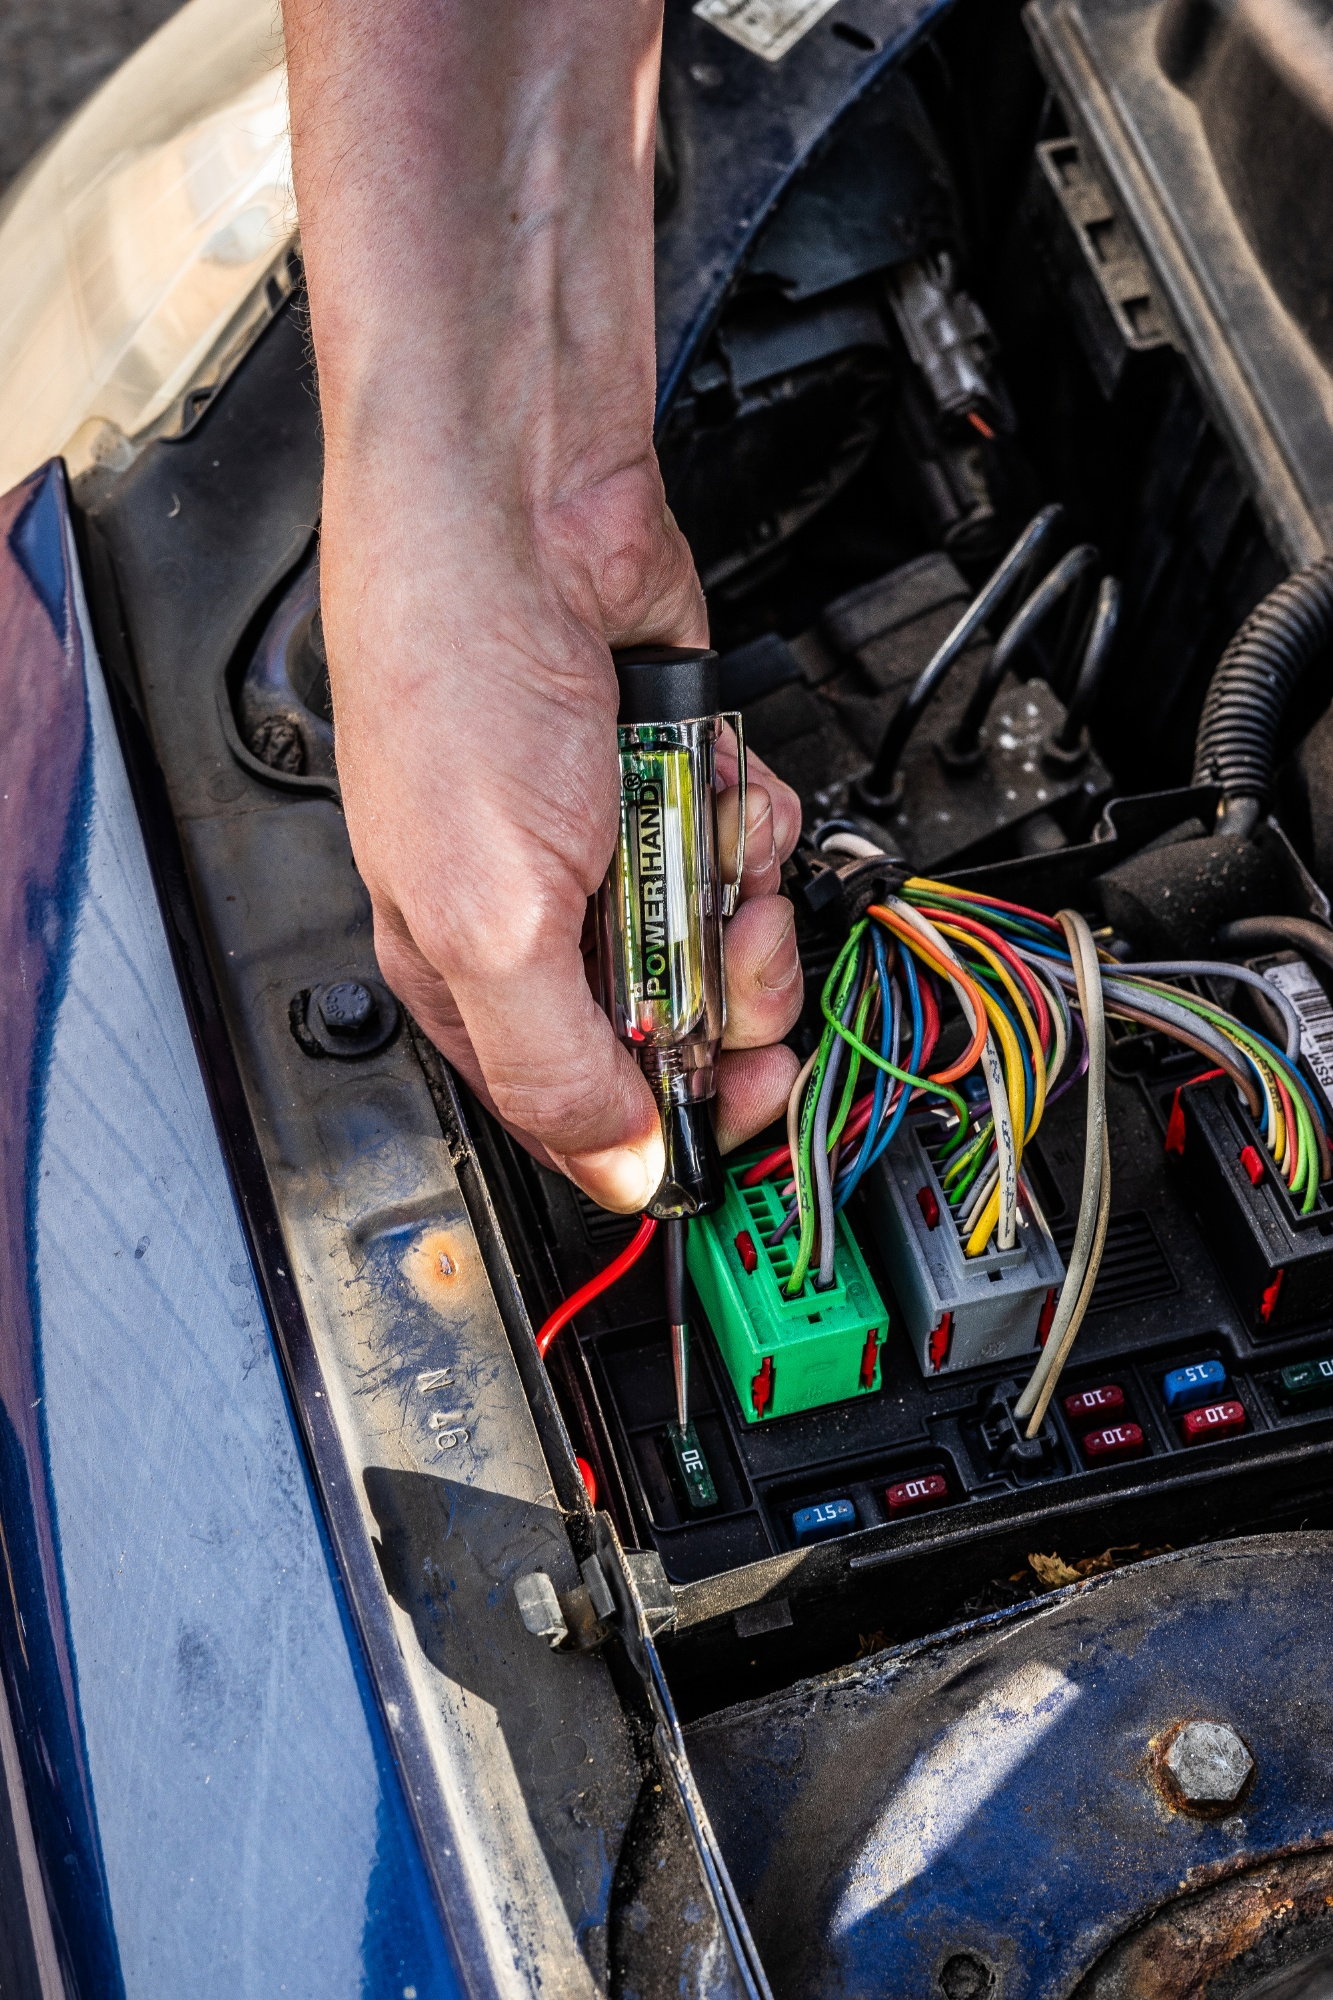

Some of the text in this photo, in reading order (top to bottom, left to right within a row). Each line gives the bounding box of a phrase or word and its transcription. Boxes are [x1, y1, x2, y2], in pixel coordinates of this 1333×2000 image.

[417, 1368, 455, 1393] N
[1186, 1364, 1209, 1382] 15
[1082, 1389, 1106, 1408] 10
[1205, 1405, 1229, 1423] 10
[1102, 1427, 1126, 1445] 10
[681, 1449, 704, 1474] 30
[905, 1479, 930, 1498] 10
[813, 1504, 837, 1523] 15
